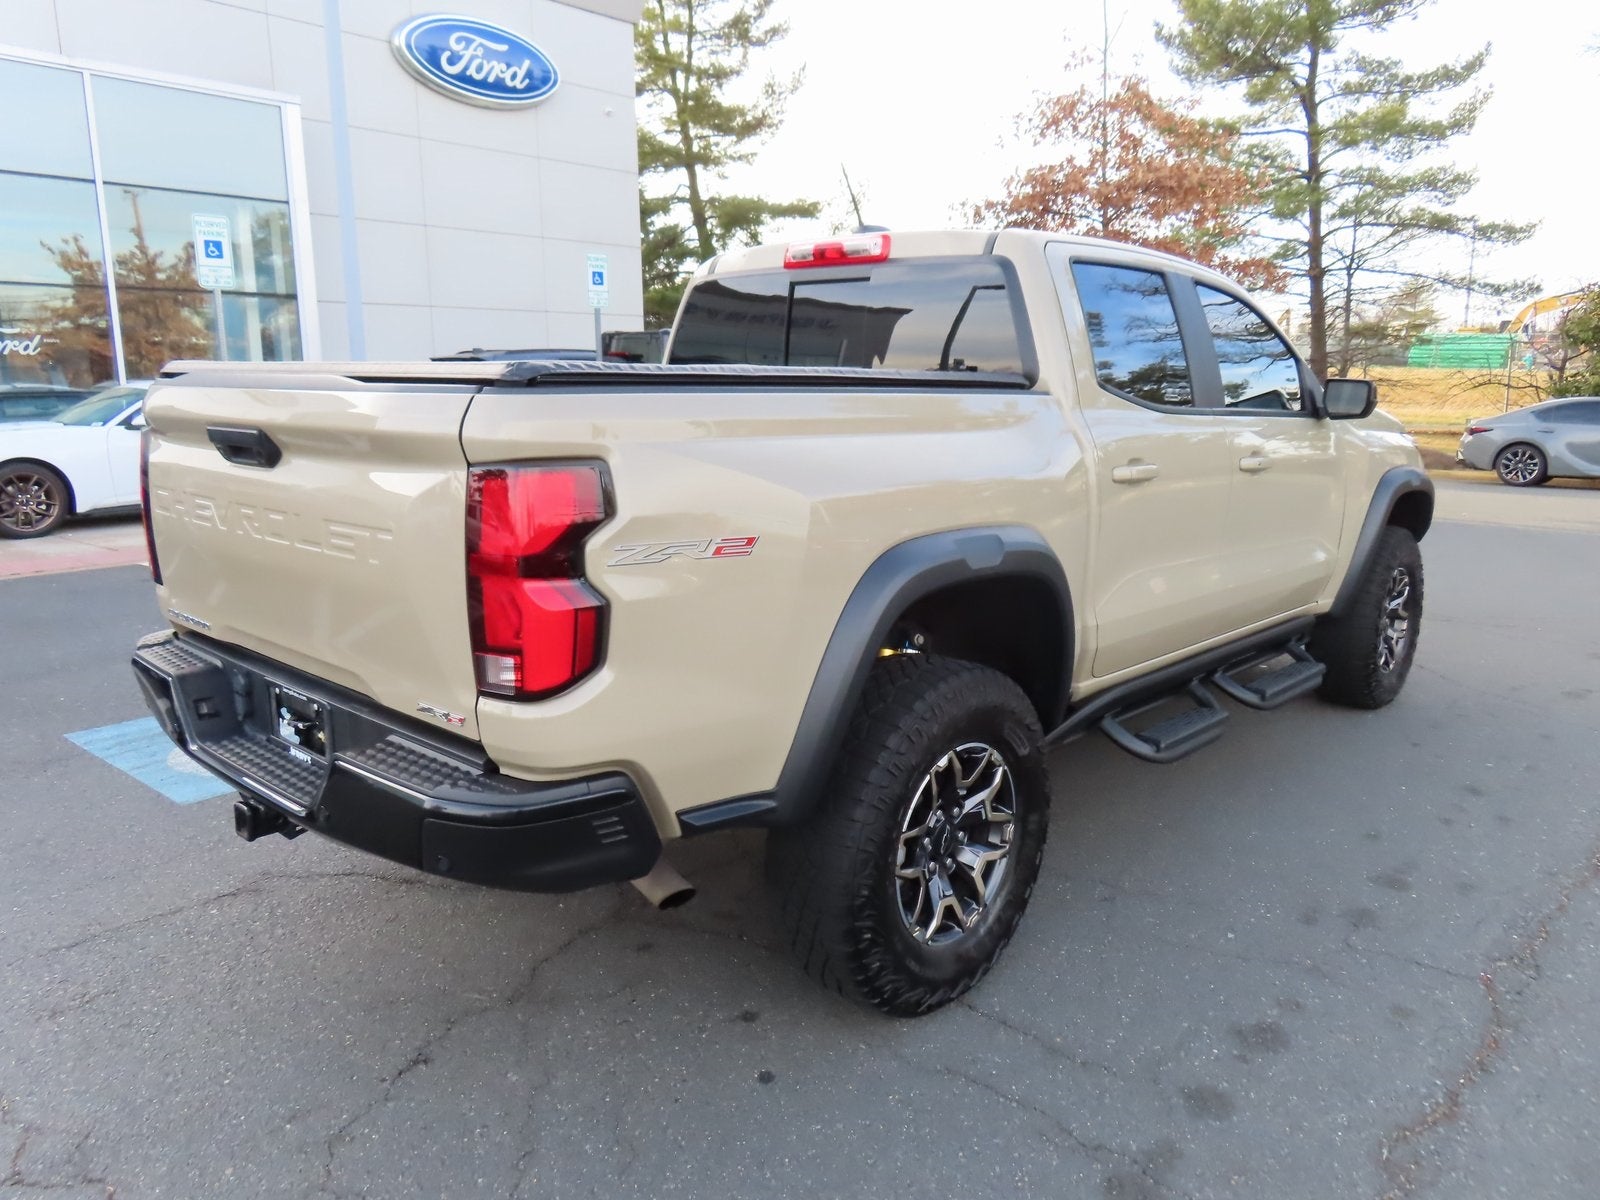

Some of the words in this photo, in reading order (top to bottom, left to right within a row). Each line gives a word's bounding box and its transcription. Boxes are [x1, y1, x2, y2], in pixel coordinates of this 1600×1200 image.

[440, 32, 531, 90] Ford
[152, 485, 393, 564] CHEVROLET
[607, 535, 760, 567] ZR2
[416, 702, 465, 727] ZR2
